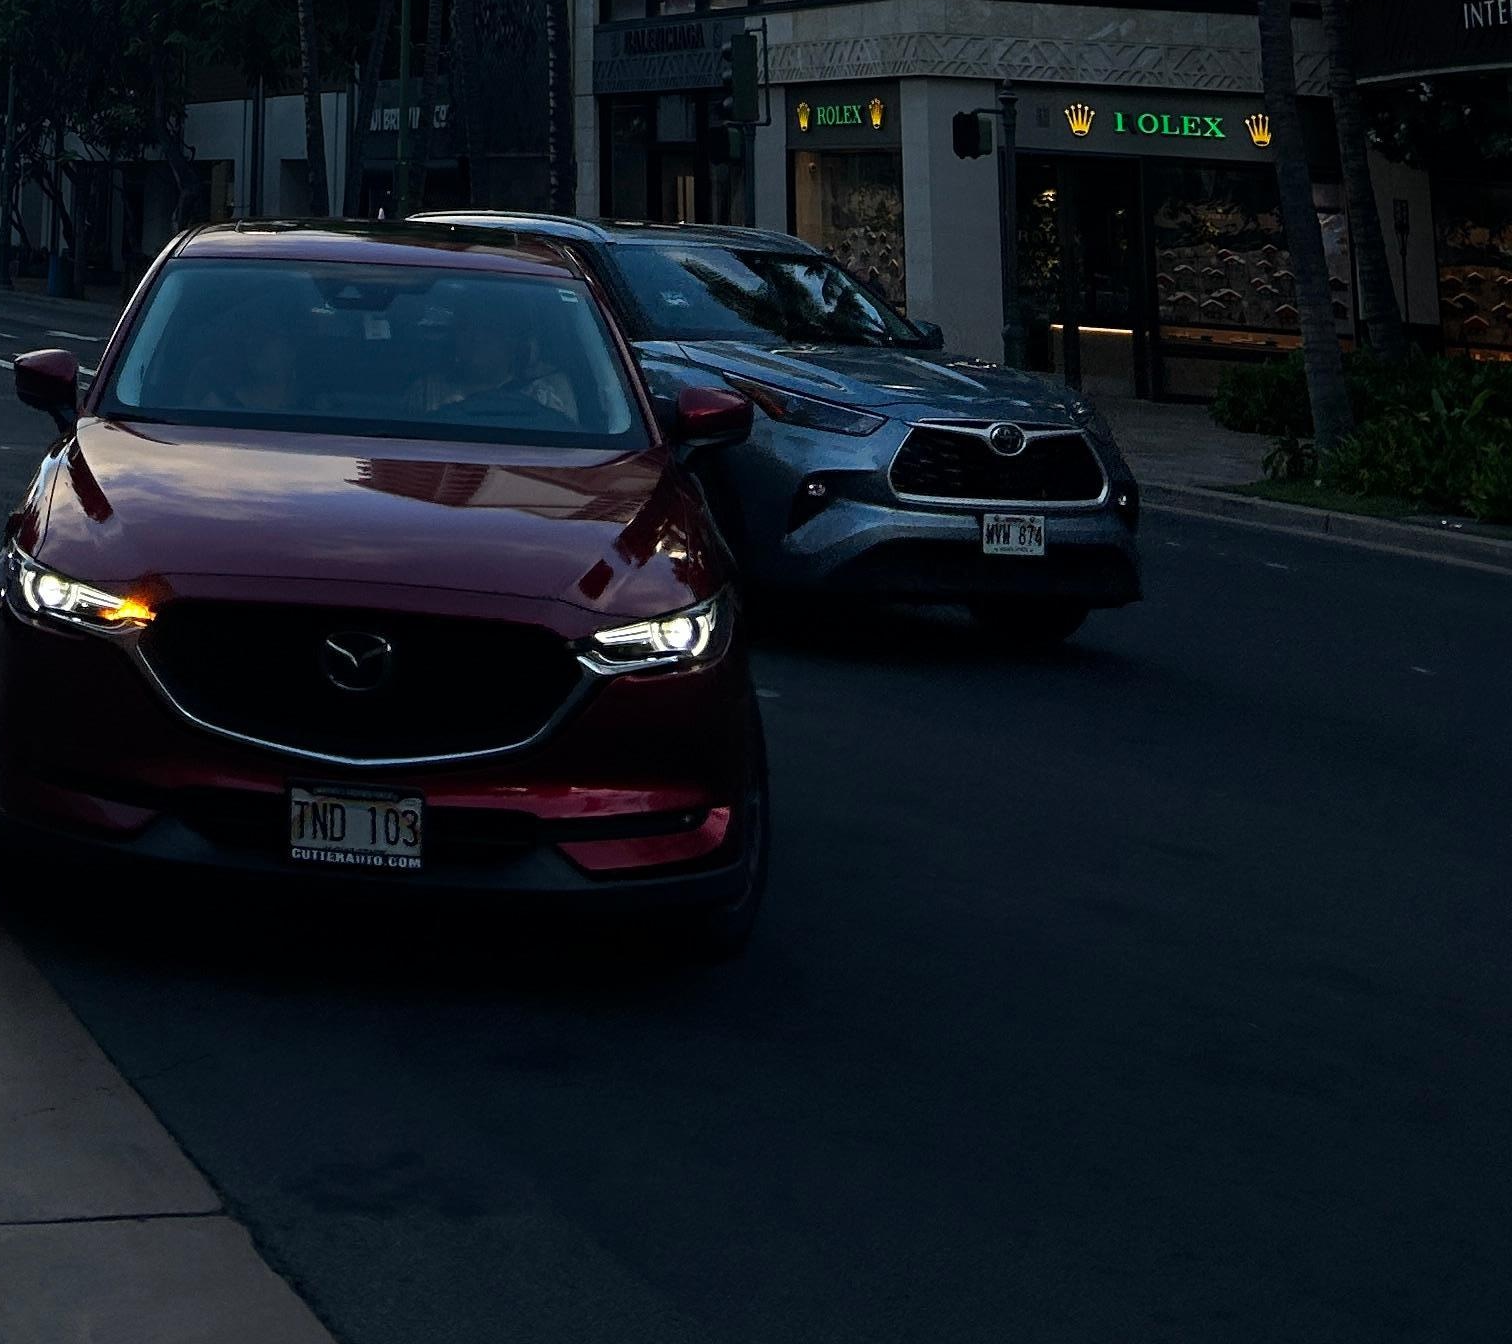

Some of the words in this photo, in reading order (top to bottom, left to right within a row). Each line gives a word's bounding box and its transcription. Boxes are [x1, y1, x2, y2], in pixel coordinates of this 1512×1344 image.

[816, 105, 862, 125] ROLEX
[292, 800, 346, 842] TND
[367, 806, 419, 848] 103
[291, 847, 422, 869] CUTTERAUTO.COM
